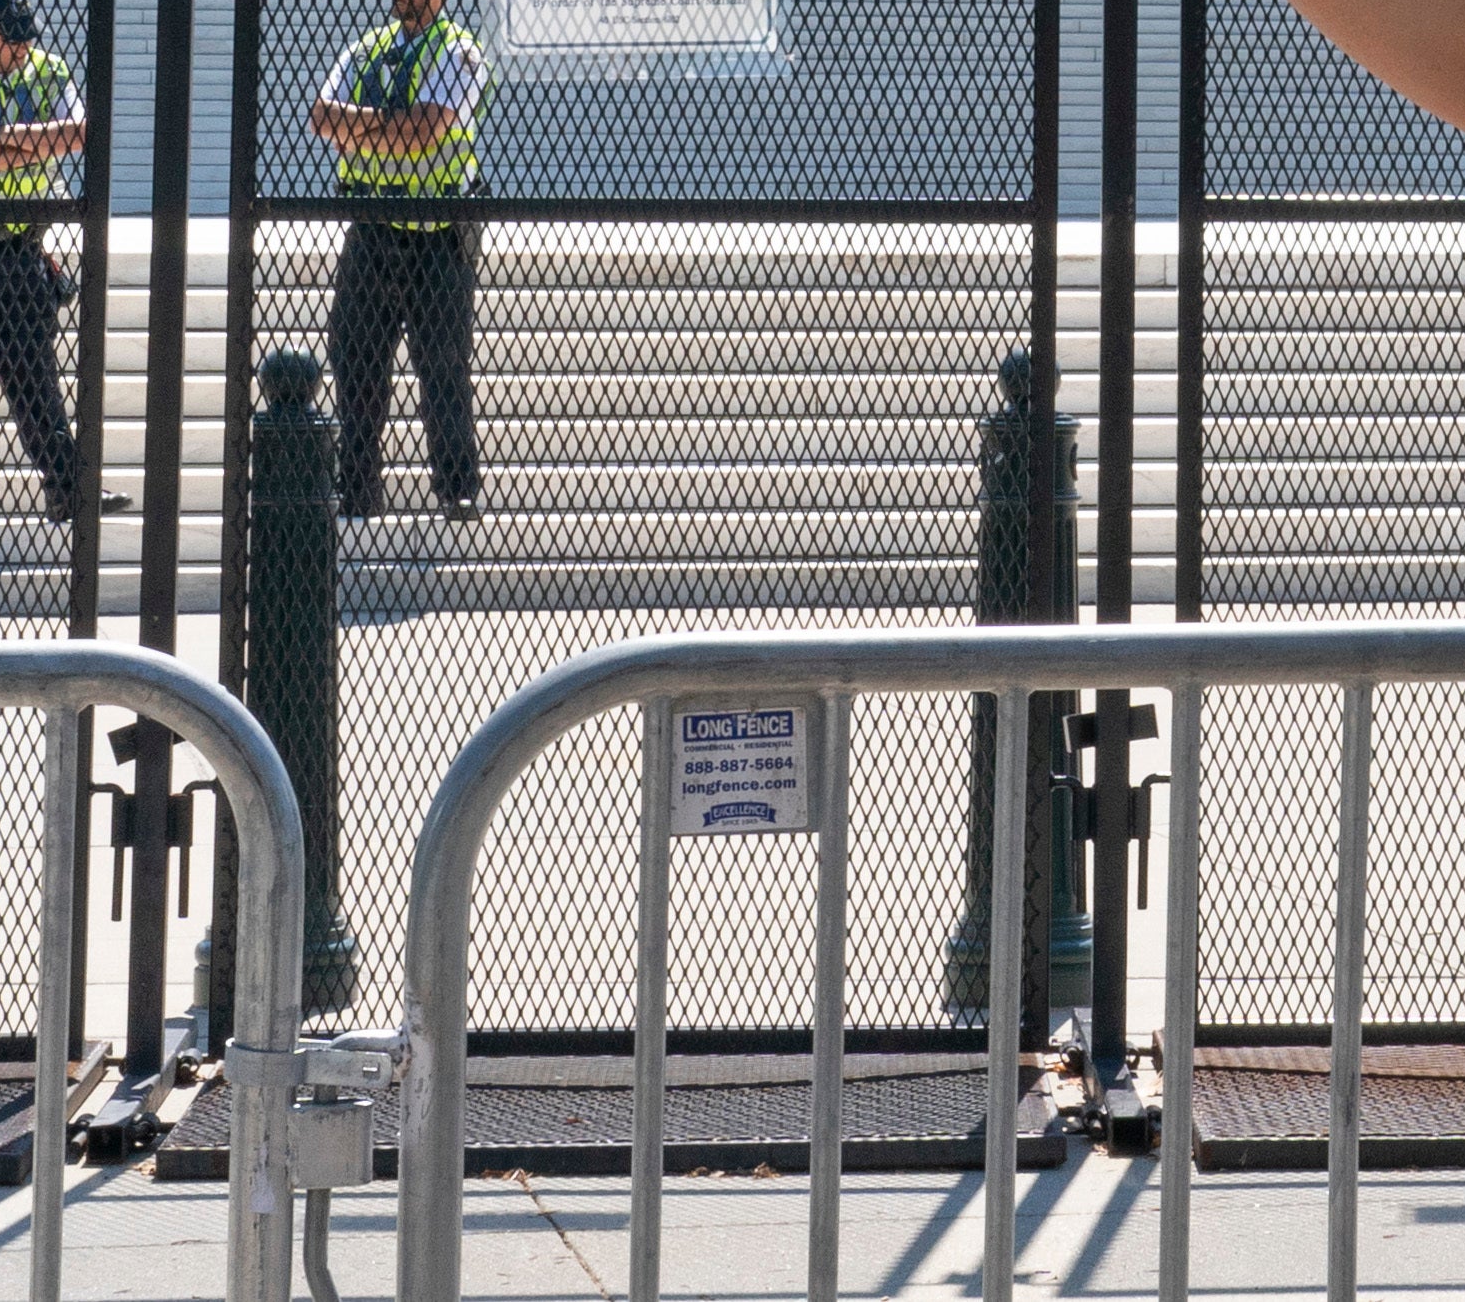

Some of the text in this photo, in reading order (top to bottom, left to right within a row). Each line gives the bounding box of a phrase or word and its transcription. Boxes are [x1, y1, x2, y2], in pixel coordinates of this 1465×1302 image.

[686, 713, 790, 739] LONG FENCE
[684, 756, 794, 775] 888-887-5664
[682, 778, 797, 796] longfence.com
